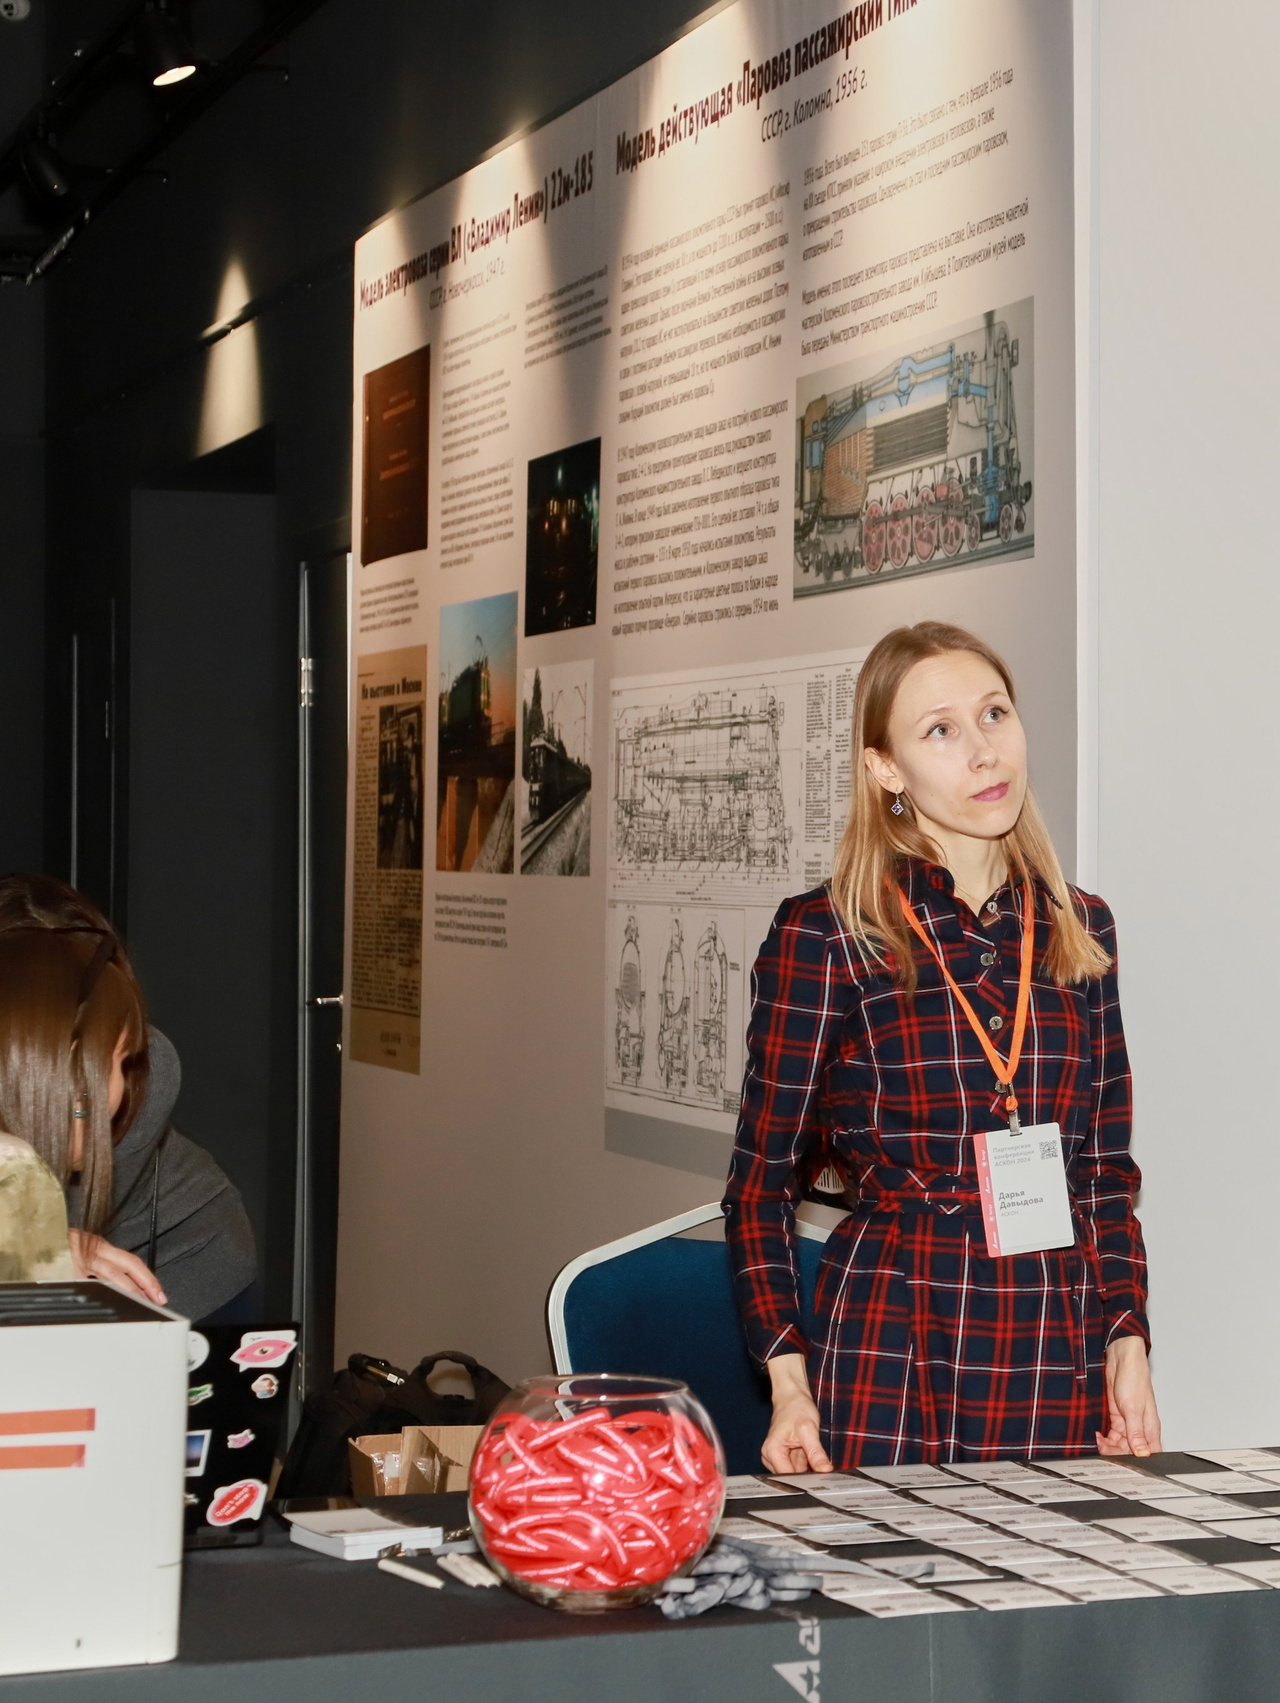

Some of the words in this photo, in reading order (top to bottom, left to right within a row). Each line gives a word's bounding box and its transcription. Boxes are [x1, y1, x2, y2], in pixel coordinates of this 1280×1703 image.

[835, 65, 859, 104] 1956
[616, 127, 656, 175] Модель
[658, 82, 733, 160] действующая
[736, 47, 791, 110] «Паровоз
[998, 1190, 1025, 1201] Дарья
[1000, 1197, 1044, 1210] Давыдова
